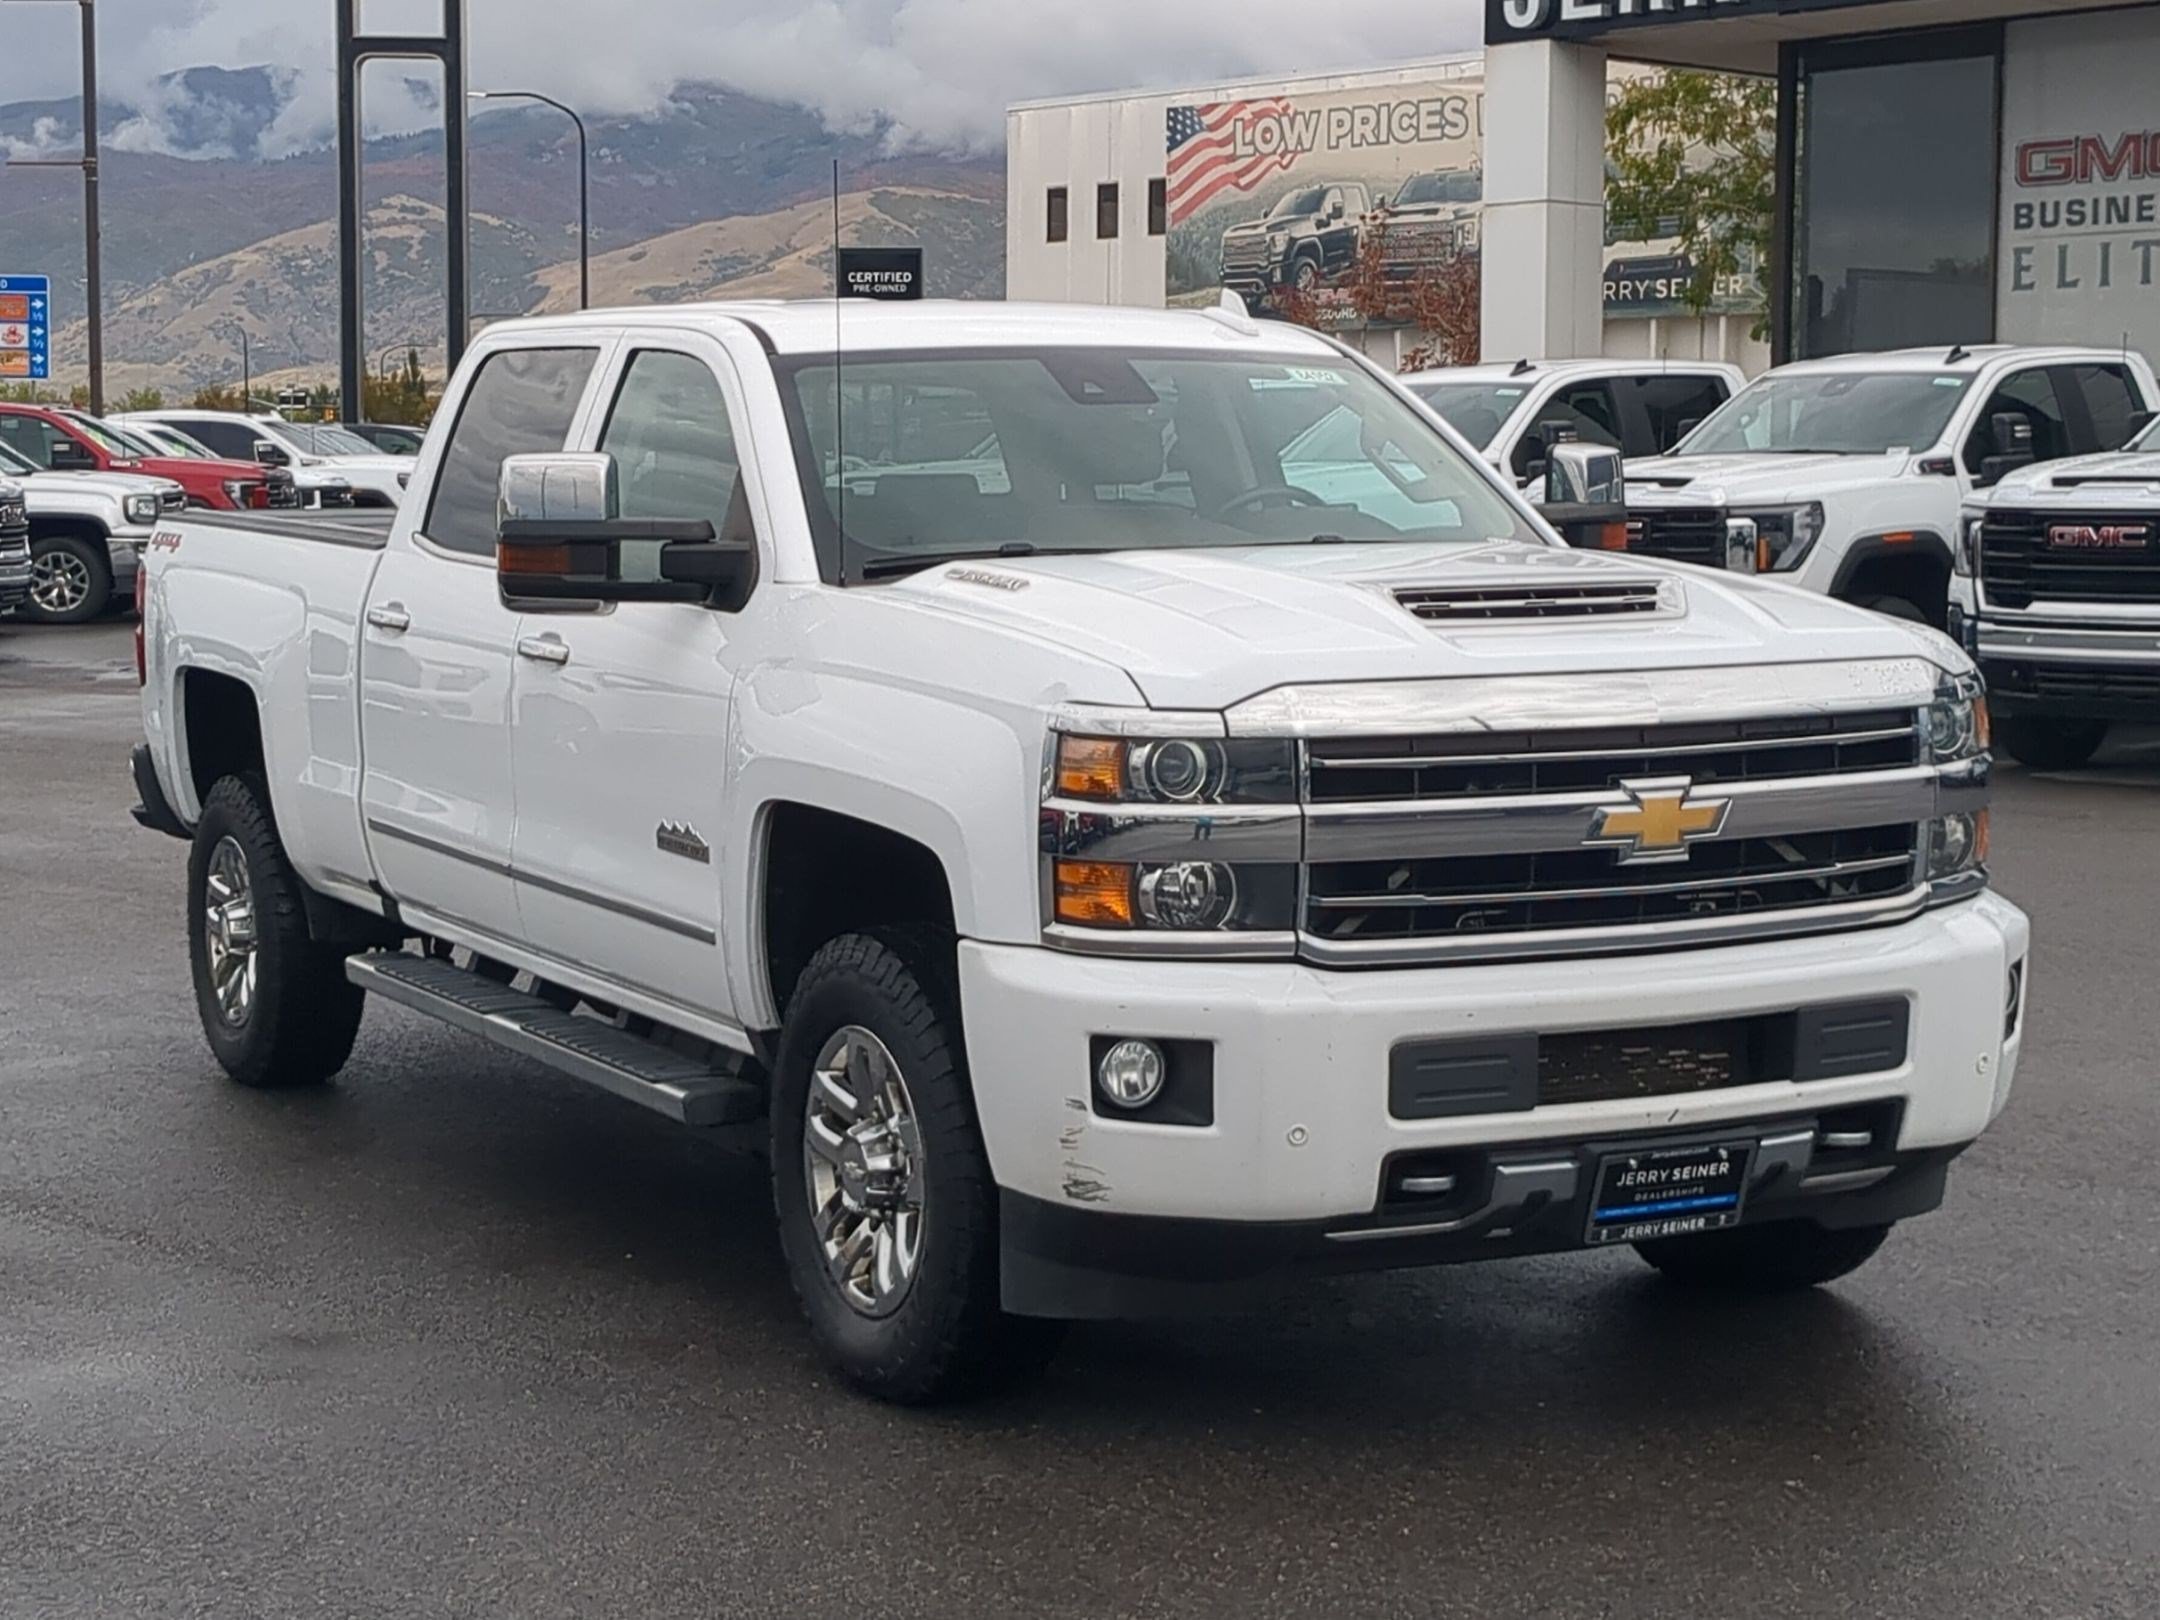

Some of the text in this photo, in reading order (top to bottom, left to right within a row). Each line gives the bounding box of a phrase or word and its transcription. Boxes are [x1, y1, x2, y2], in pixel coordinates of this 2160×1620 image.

[1233, 110, 1320, 158] LOW
[1327, 96, 1469, 150] PRICES
[2015, 131, 2160, 187] GM
[848, 271, 913, 283] CERTIFIED
[853, 284, 907, 293] PRE-OWNED
[2050, 525, 2146, 547] GMC
[1616, 1162, 1730, 1187] JERRY SEINER
[1634, 1186, 1705, 1201] DEALERSHIPS
[1621, 1217, 1706, 1240] JERRY SEINER
